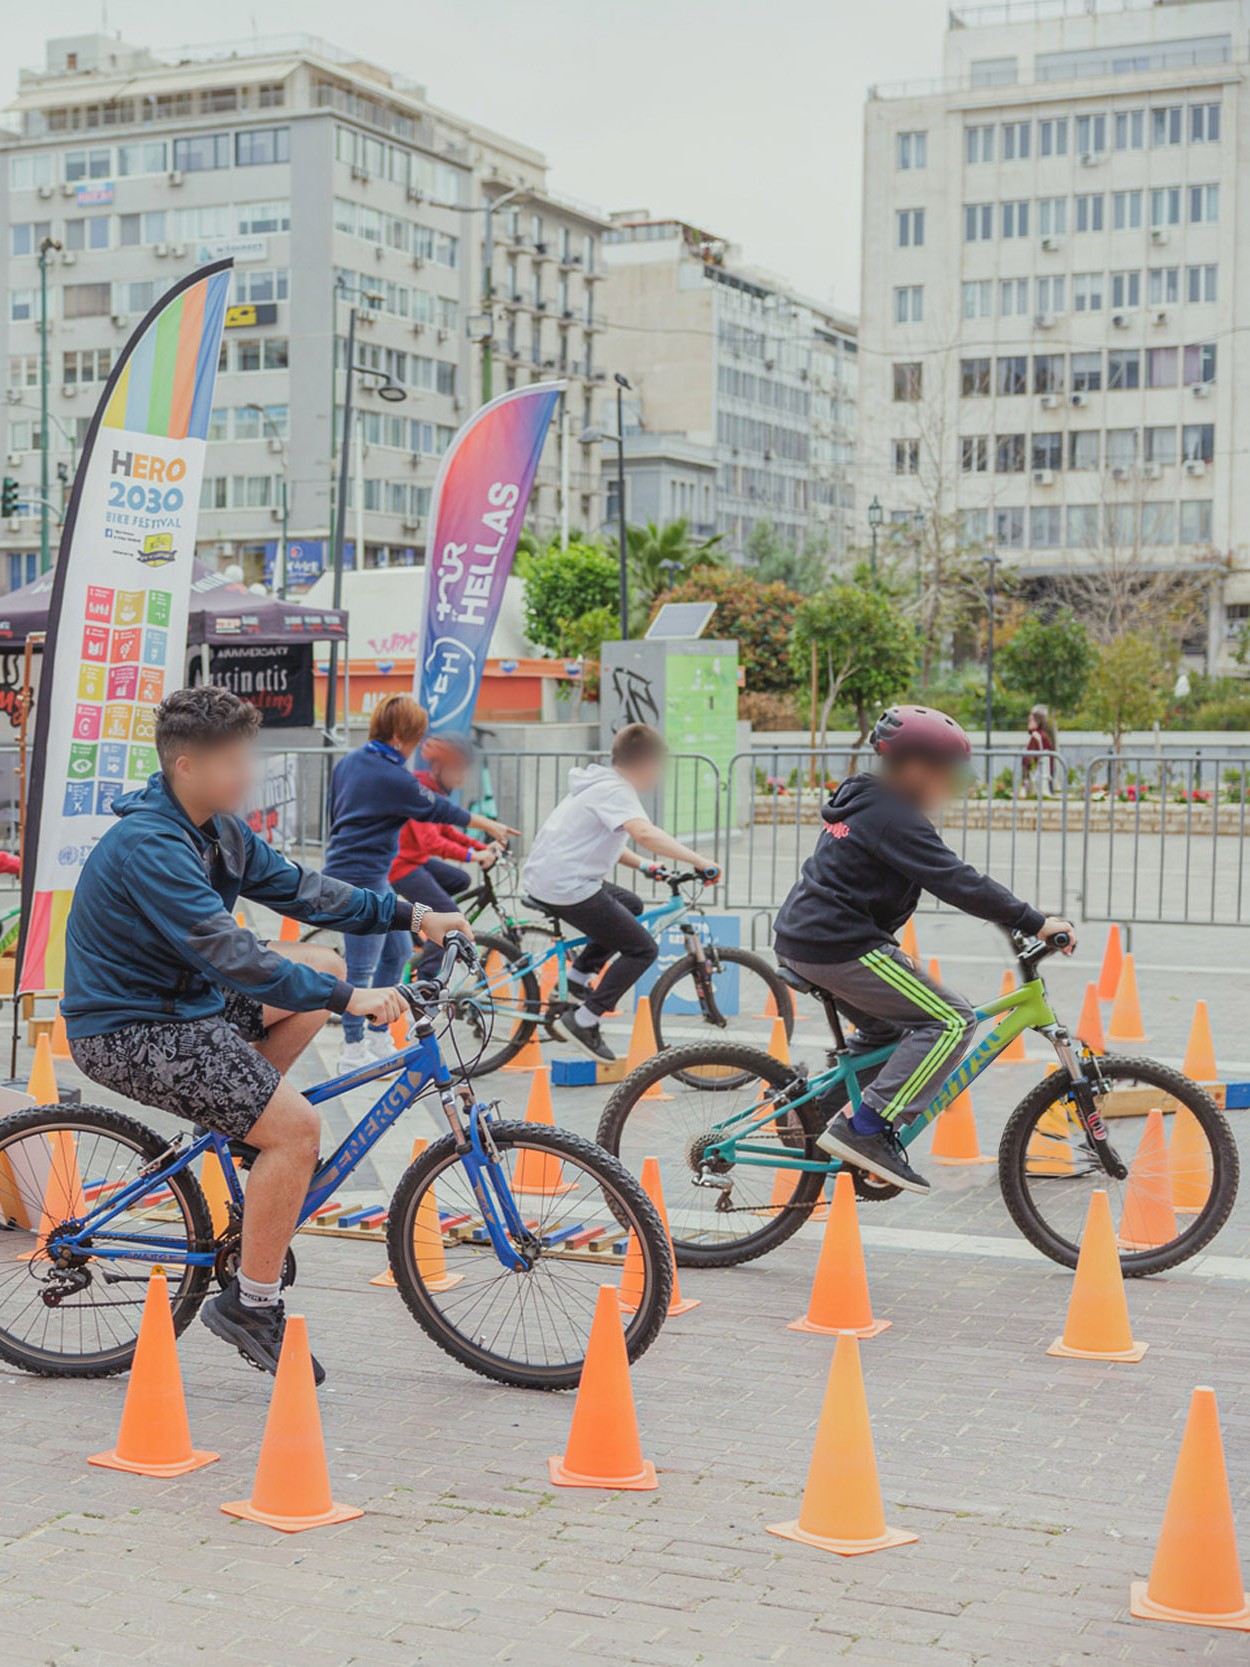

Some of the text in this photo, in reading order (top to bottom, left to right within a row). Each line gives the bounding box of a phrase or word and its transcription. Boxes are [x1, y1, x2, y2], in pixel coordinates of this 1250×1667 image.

[111, 449, 186, 483] HERO
[108, 481, 184, 514] 2030
[457, 482, 519, 625] HELLAS
